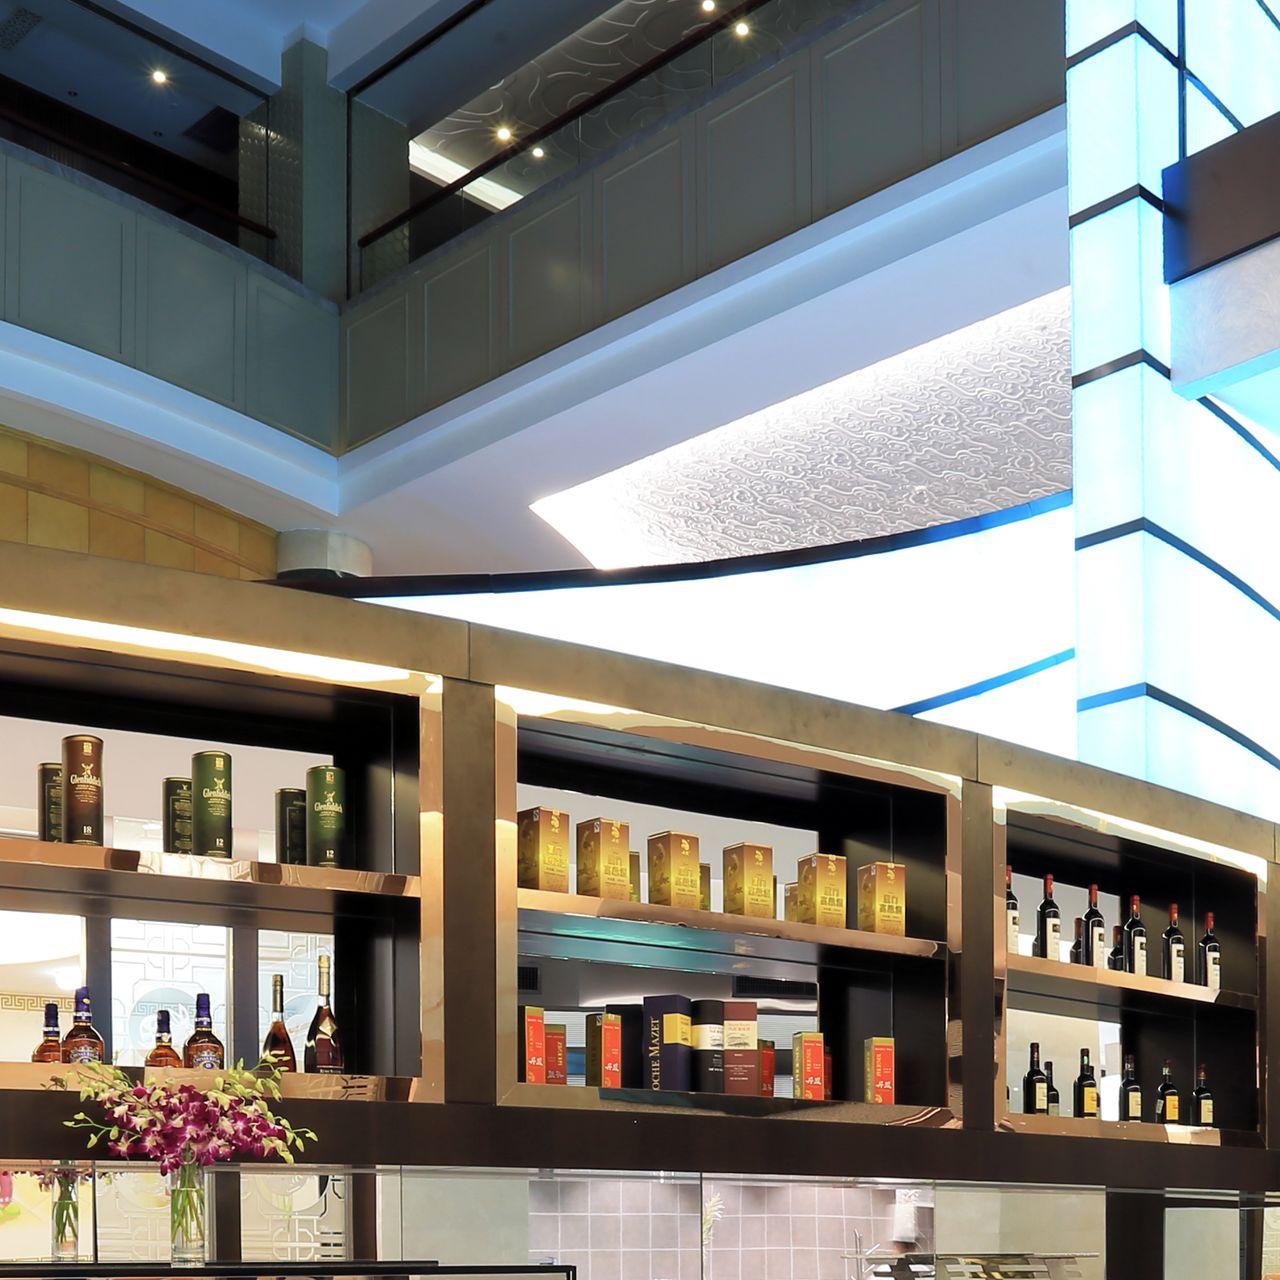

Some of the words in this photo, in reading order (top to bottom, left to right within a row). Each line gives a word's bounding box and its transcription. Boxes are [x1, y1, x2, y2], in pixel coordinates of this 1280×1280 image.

[314, 802, 343, 815] Glenfiddich
[83, 825, 92, 834] 18
[216, 838, 224, 847] 12
[326, 850, 335, 859] 12
[649, 1018, 660, 1057] MAZET
